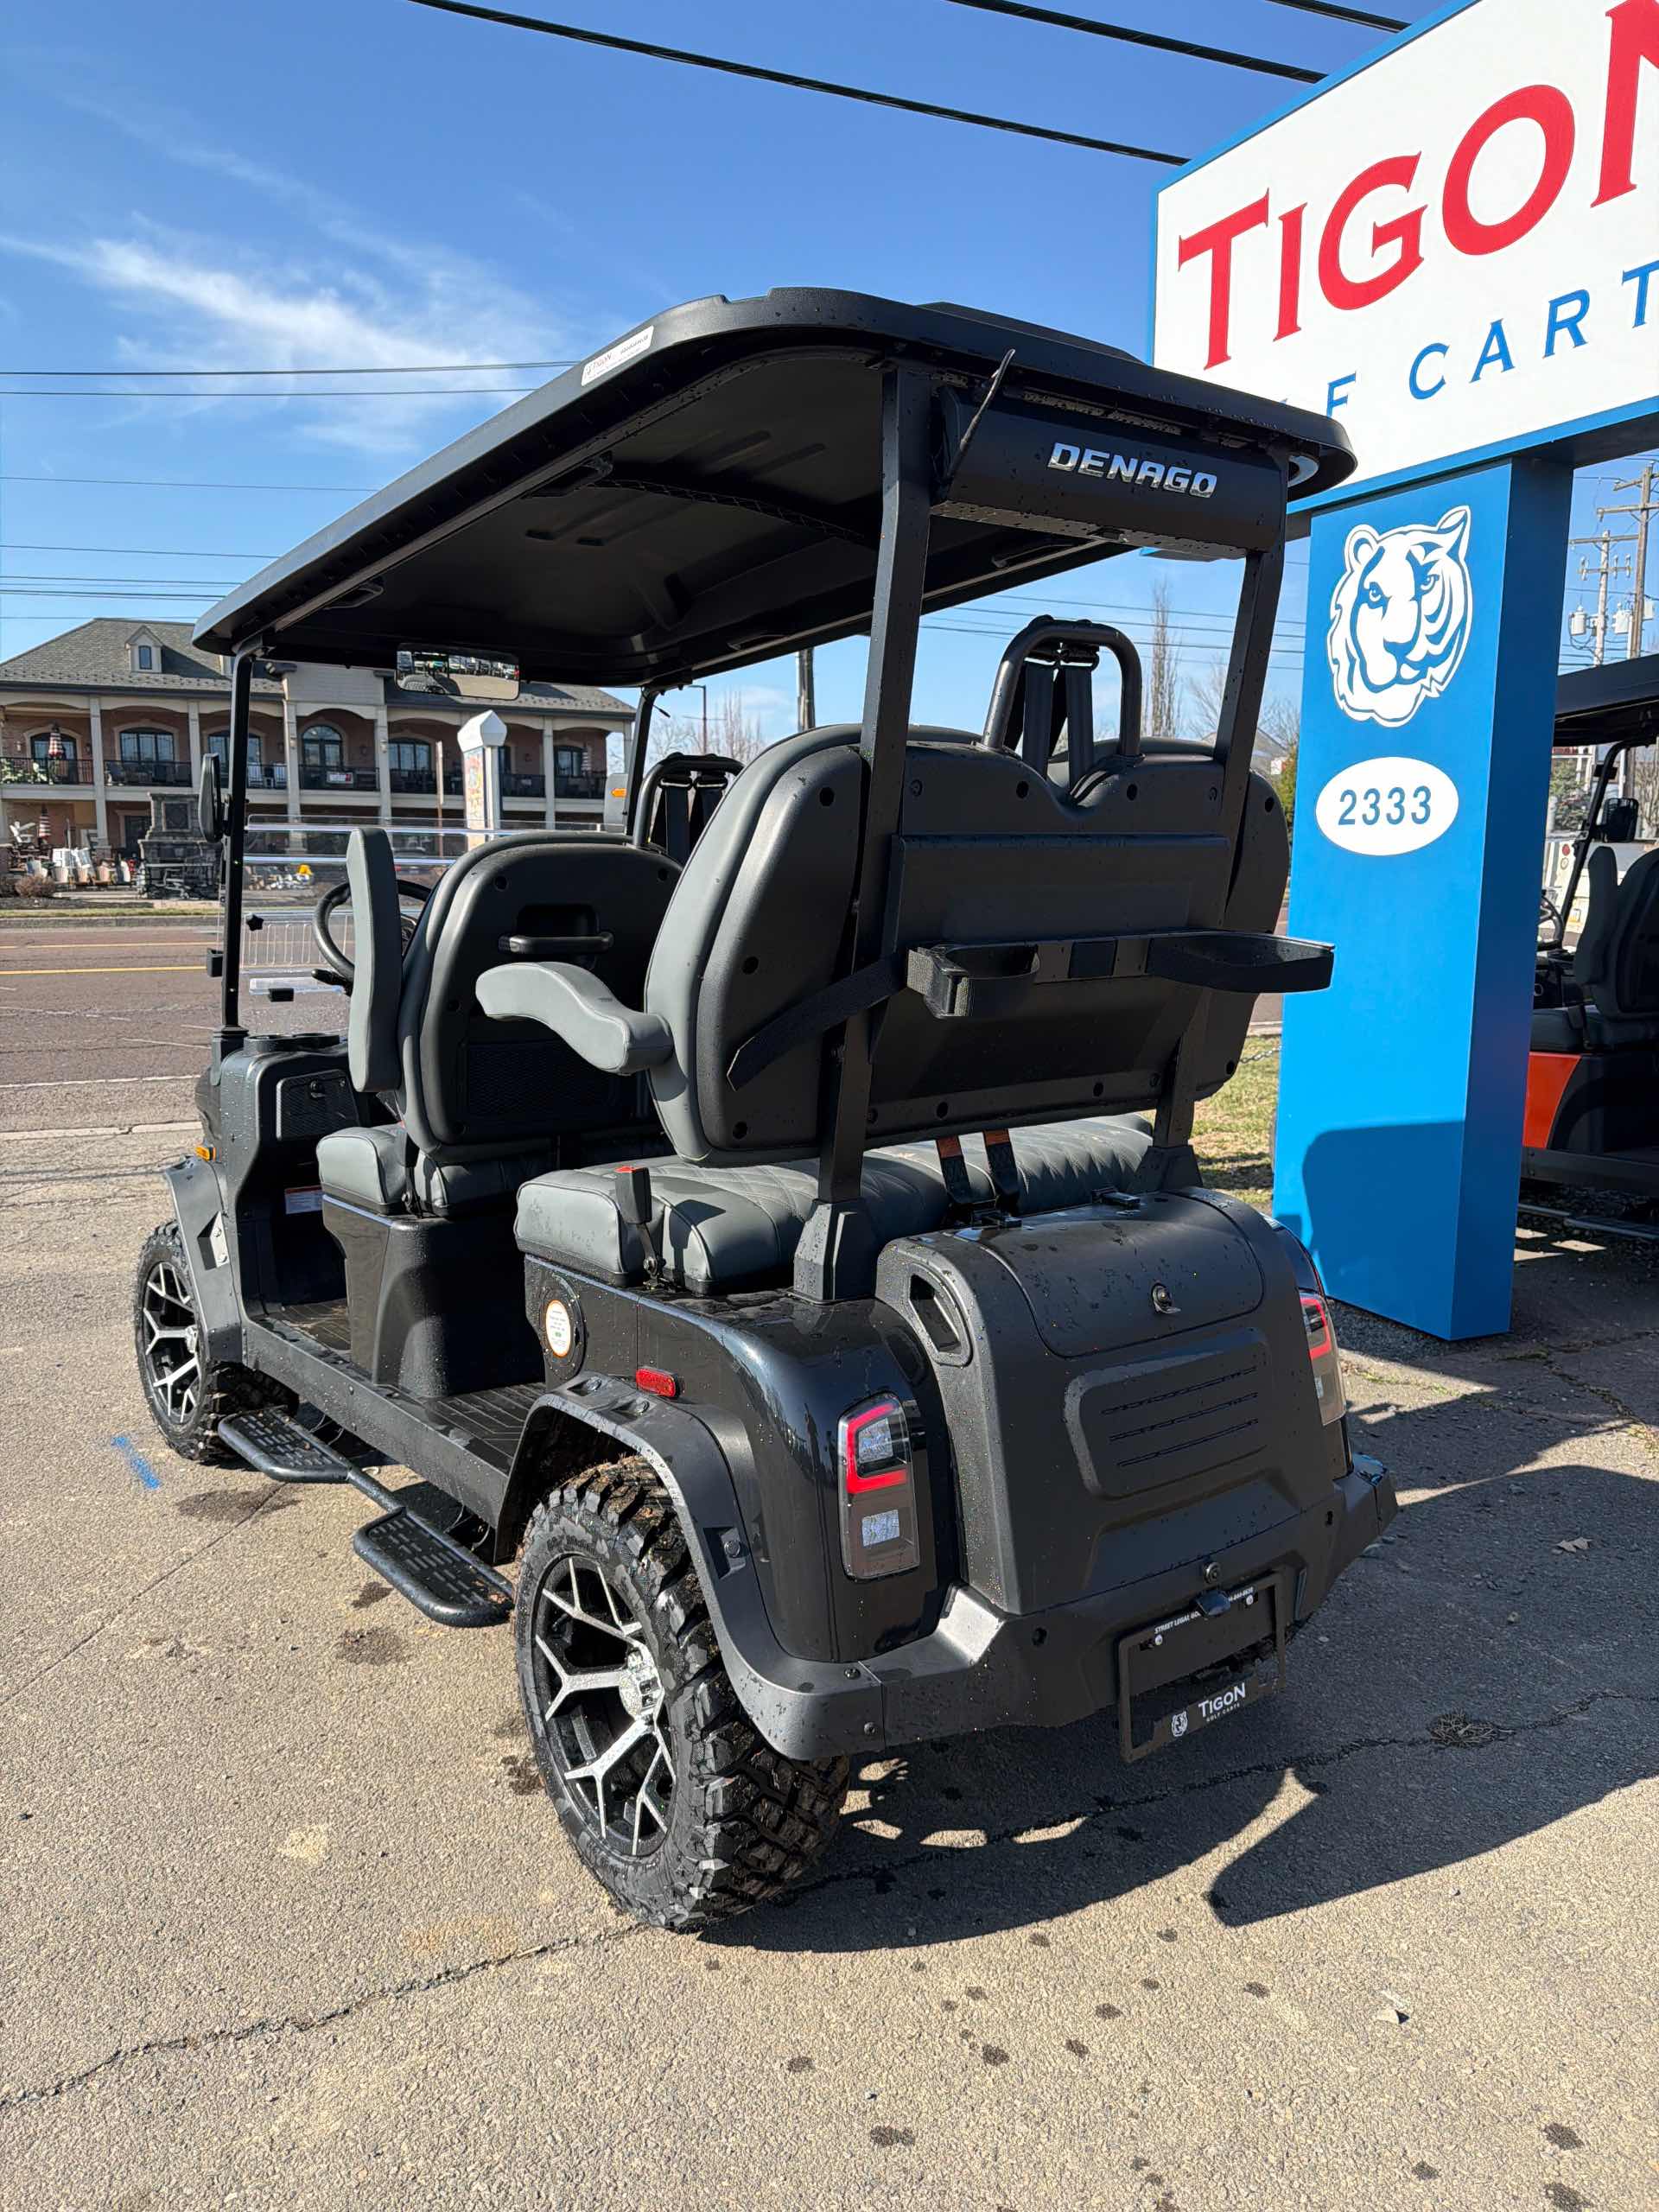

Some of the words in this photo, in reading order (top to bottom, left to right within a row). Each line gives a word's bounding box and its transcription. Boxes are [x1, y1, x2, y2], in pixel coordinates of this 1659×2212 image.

[1047, 442, 1217, 499] DENAGO
[1338, 785, 1432, 826] 2333
[1198, 1682, 1246, 1718] TIGON
